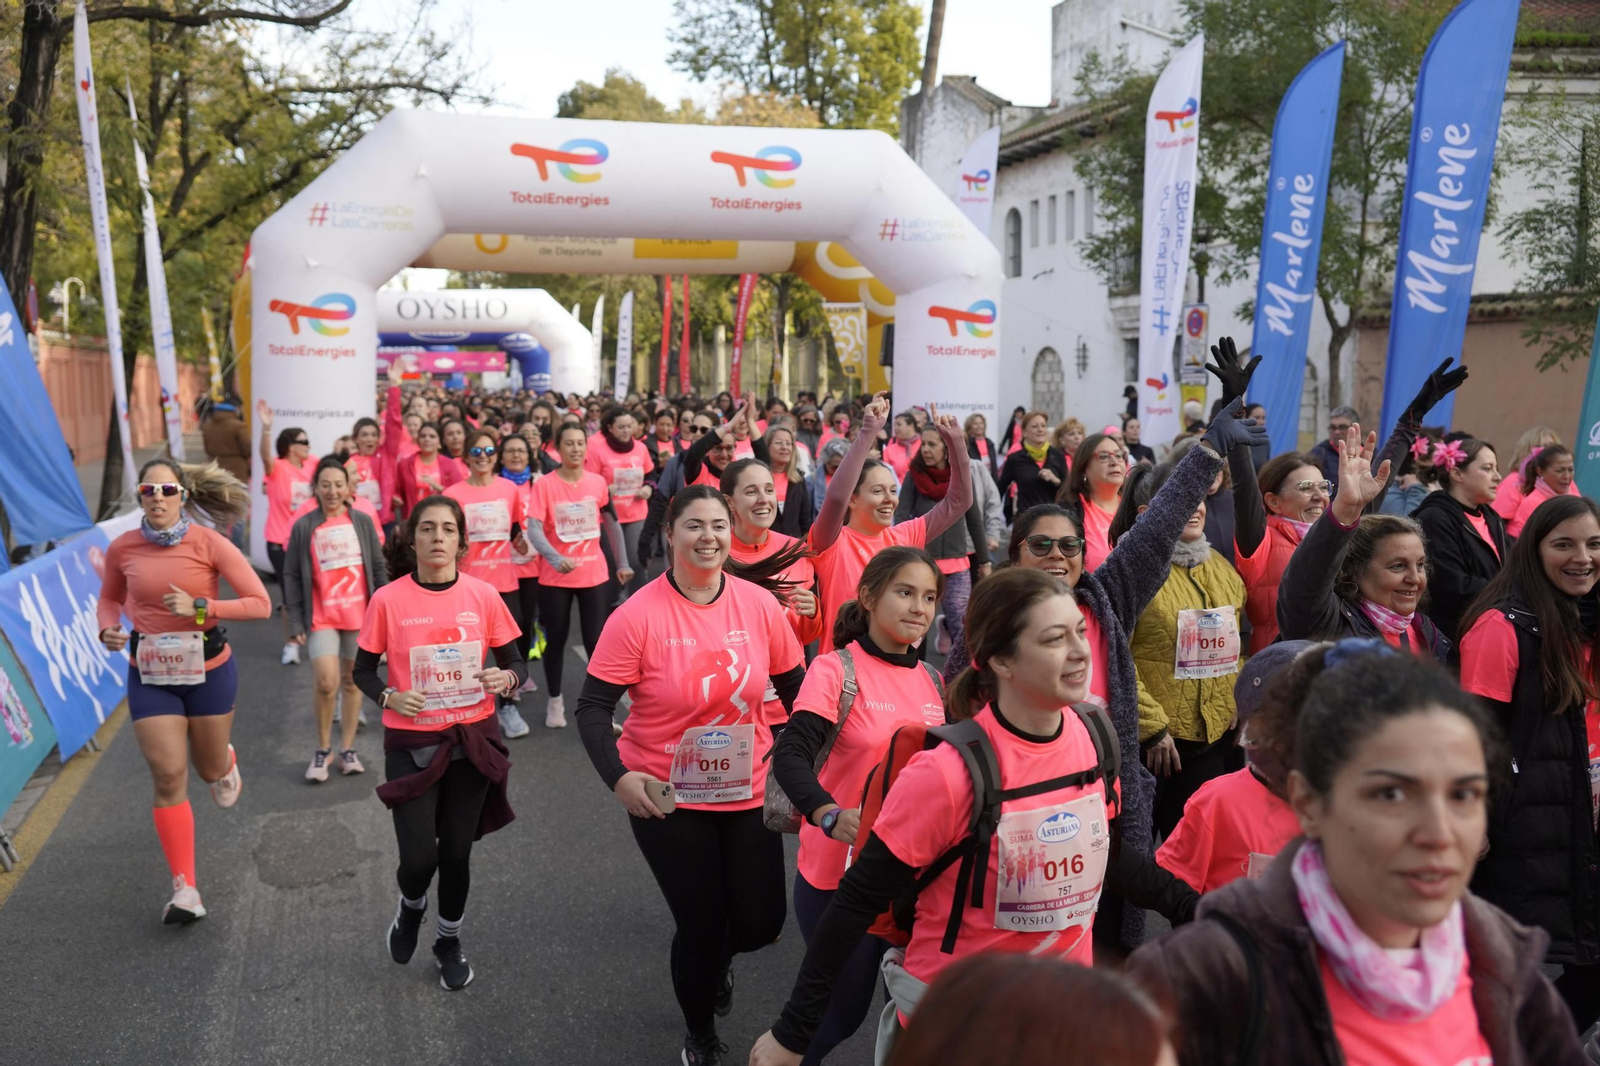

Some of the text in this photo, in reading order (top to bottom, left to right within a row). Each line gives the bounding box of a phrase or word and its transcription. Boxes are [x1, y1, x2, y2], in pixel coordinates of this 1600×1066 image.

[510, 191, 609, 207] TotalEnergies
[710, 197, 802, 212] TotalEnergies
[1405, 123, 1477, 314] Marlene
[1264, 174, 1314, 337] Marlene
[397, 298, 507, 320] OYSHO
[268, 344, 356, 359] TotalEnergies
[927, 345, 996, 358] TotalEnergies
[402, 616, 434, 626] OYSHO
[665, 638, 697, 647] OYSHO
[1200, 637, 1225, 650] 016
[159, 655, 184, 664] 016
[436, 670, 463, 683] 016
[861, 700, 896, 712] OYSHO
[699, 738, 730, 746] ASTURIANA
[699, 758, 730, 772] 016
[721, 790, 744, 798] Santander
[1040, 822, 1079, 839] ASTURIANA
[1009, 834, 1034, 845] SUMA
[1043, 854, 1084, 881] 016
[1057, 885, 1073, 896] 757
[1017, 903, 1046, 911] CARRERA
[1047, 901, 1055, 909] DE
[1055, 899, 1063, 908] LA
[1063, 896, 1080, 906] MUJER
[1010, 914, 1054, 925] OYSHO
